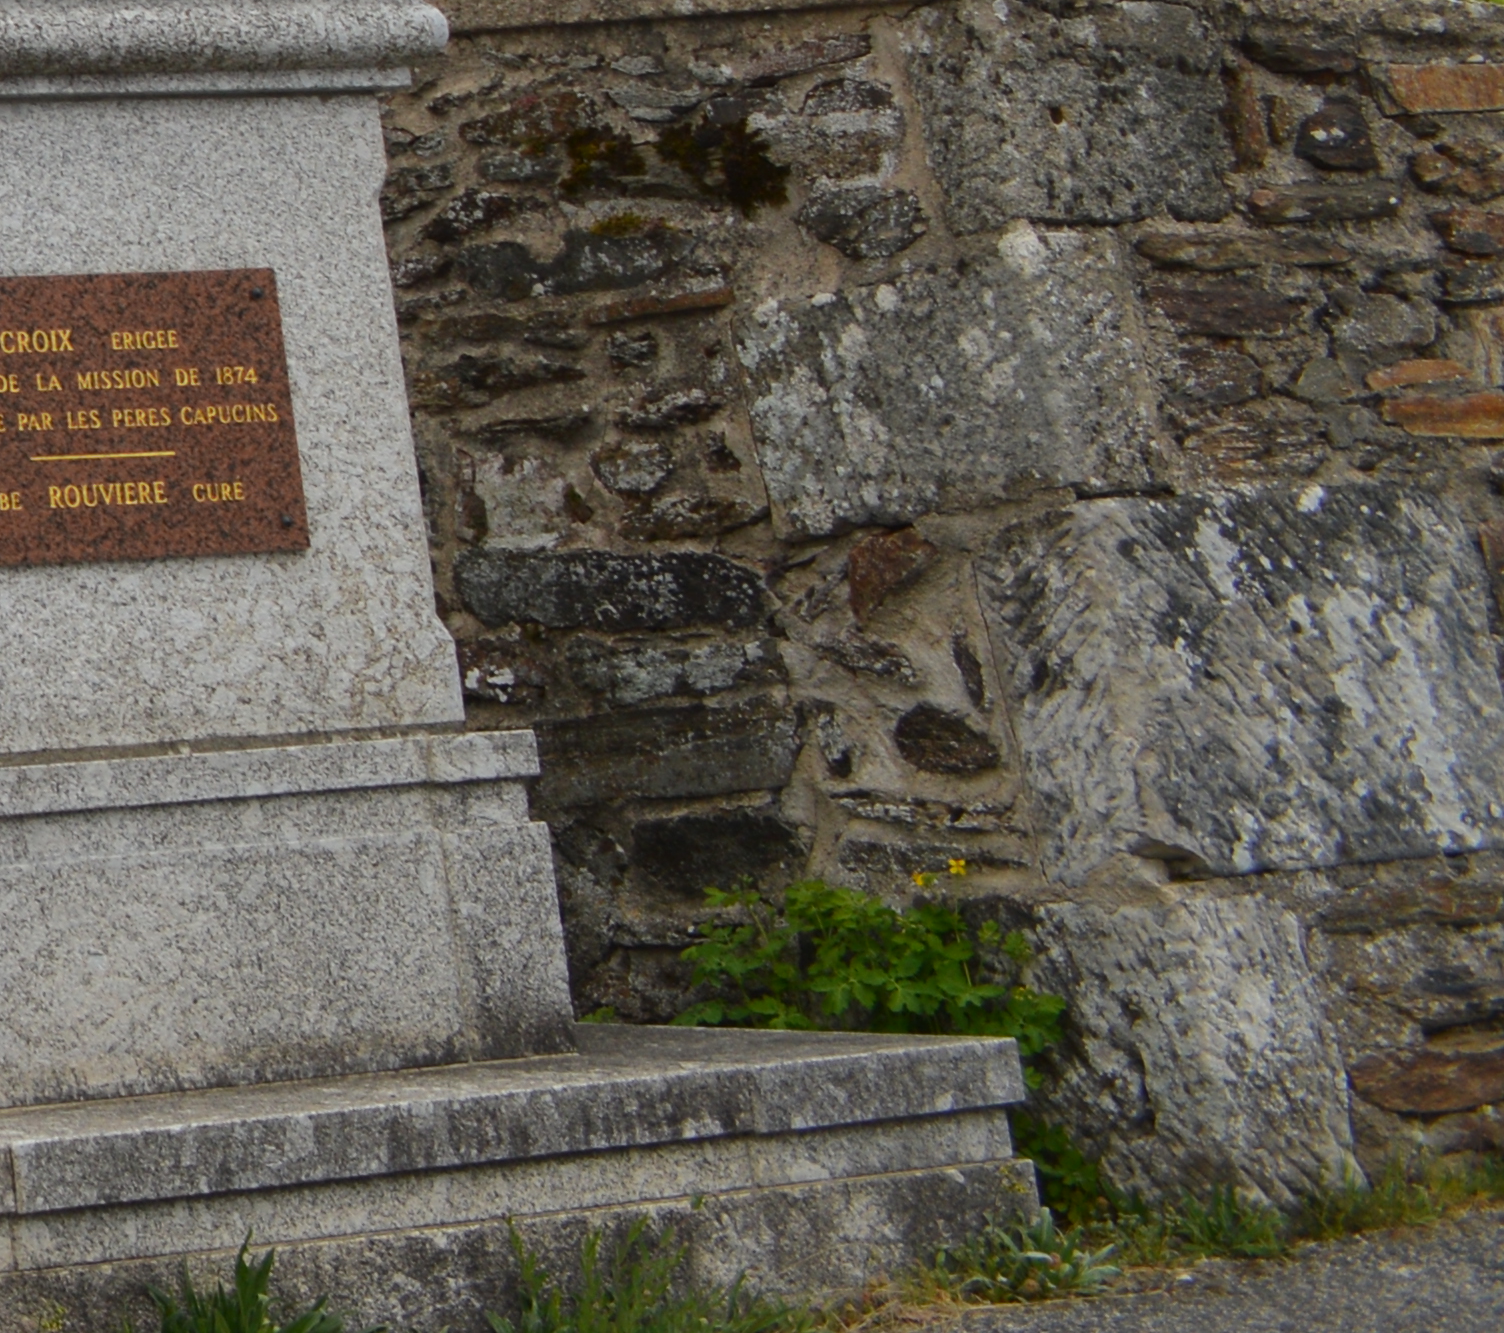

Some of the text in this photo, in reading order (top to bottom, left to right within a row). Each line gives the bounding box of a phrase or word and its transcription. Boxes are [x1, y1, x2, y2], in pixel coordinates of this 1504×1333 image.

[0, 329, 179, 354] CROIX ERIGEE
[36, 373, 62, 392] LA
[77, 368, 160, 391] MISSION
[175, 367, 201, 387] DE
[216, 366, 258, 385] 1874
[17, 412, 54, 432] PAR
[67, 409, 102, 430] LES
[112, 407, 172, 428] PERES
[180, 403, 278, 426] CAPUCINS
[48, 480, 168, 509] ROUVIERE
